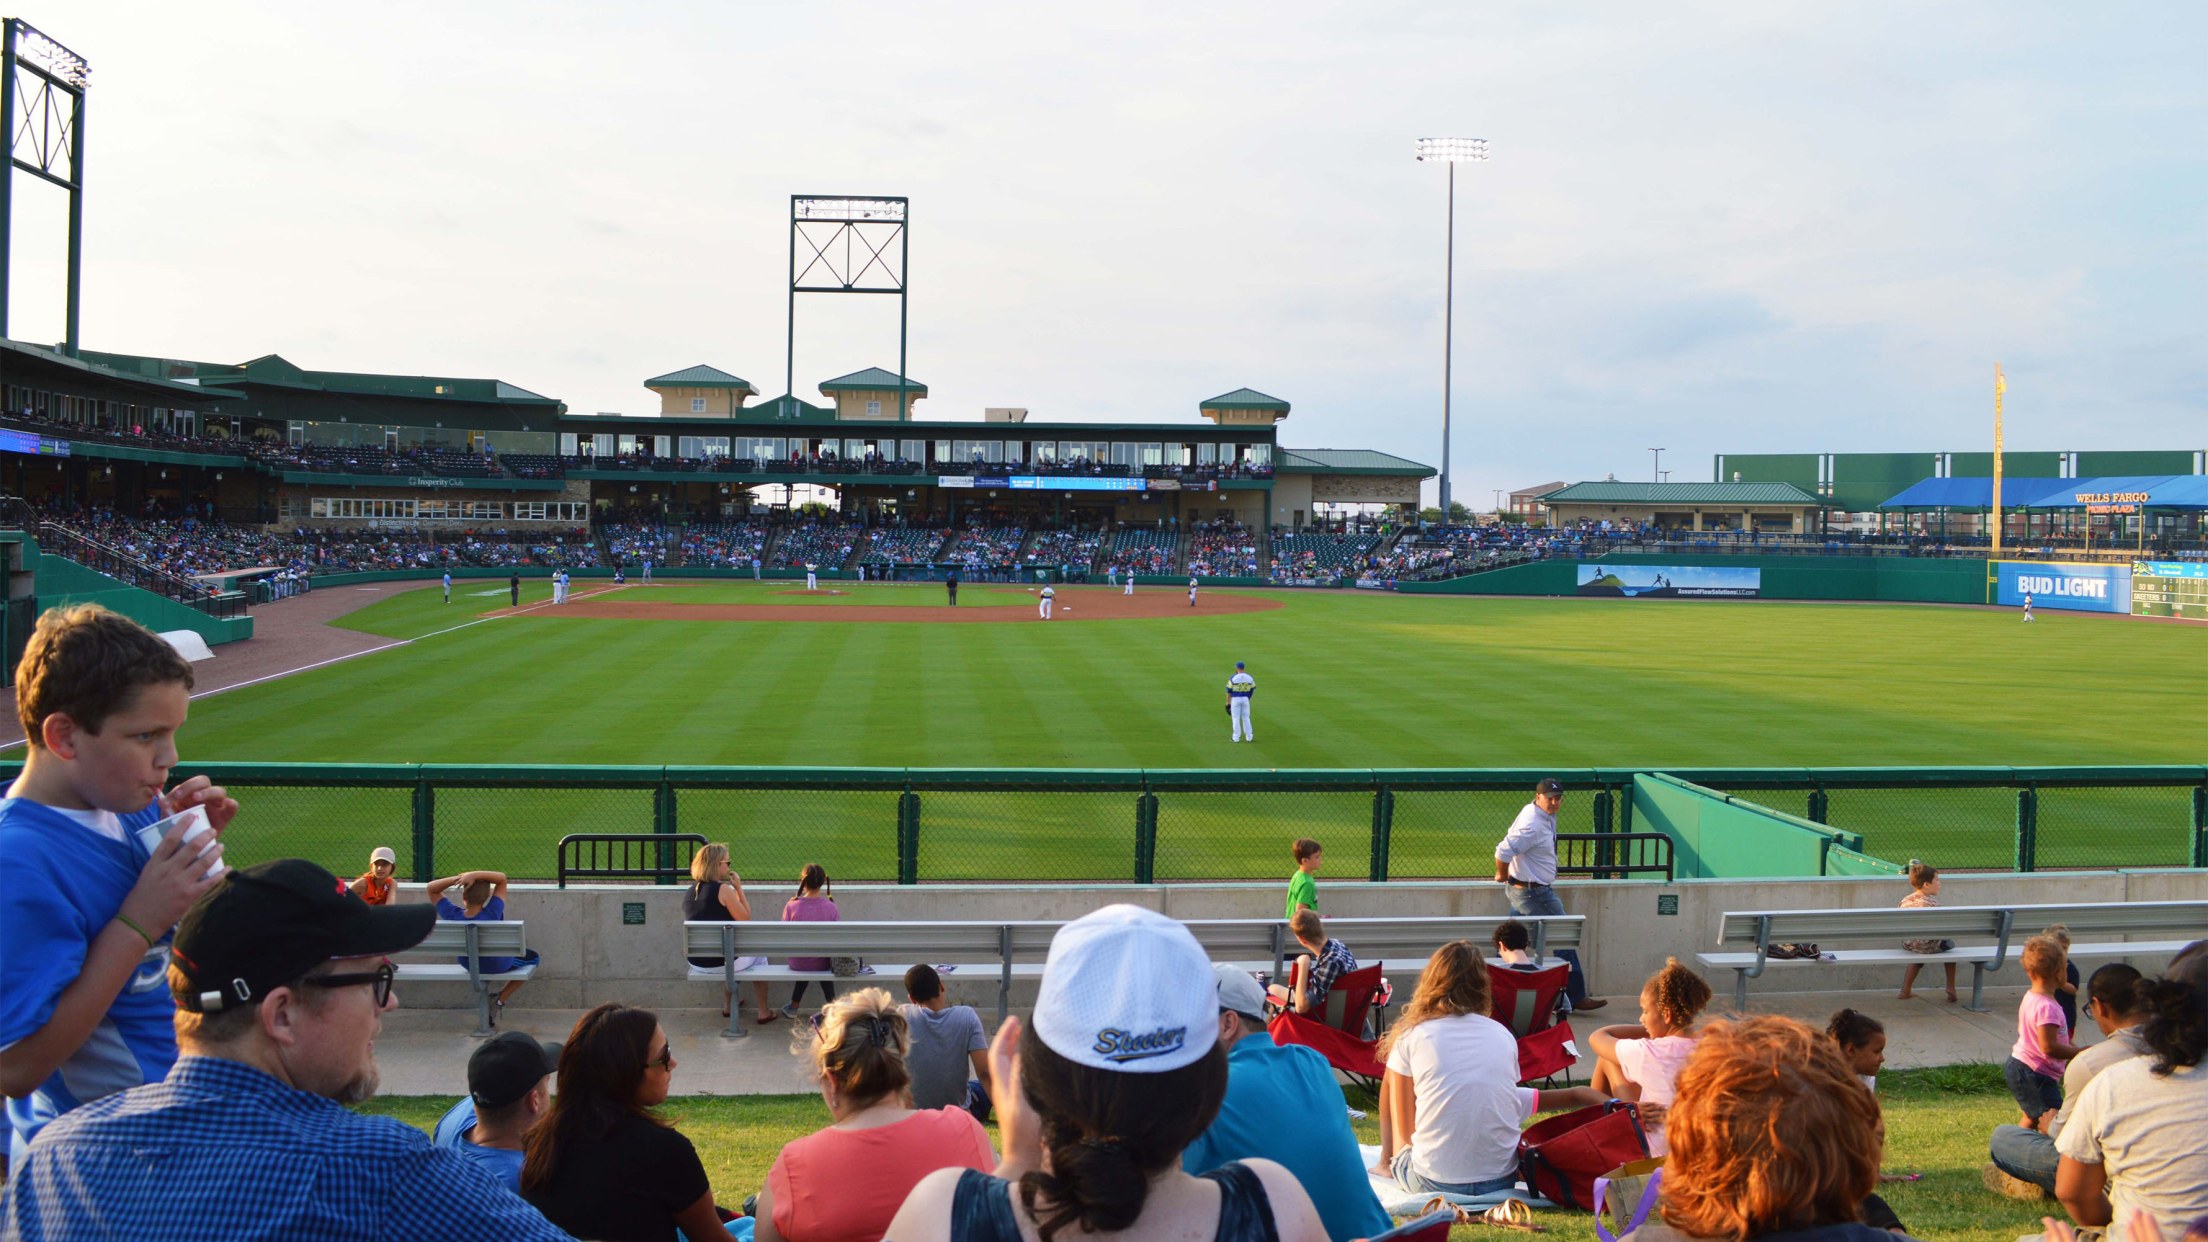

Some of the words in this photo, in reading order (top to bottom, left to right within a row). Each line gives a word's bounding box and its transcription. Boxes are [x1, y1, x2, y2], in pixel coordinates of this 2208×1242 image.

[417, 478, 448, 487] Insperity
[449, 478, 464, 486] Club
[2075, 493, 2110, 503] WELLS
[2112, 492, 2149, 503] FARGO
[2085, 505, 2110, 513] PICNIC
[2110, 504, 2136, 513] PLAZA
[2017, 575, 2054, 595] BUD
[2055, 577, 2107, 598] LIGHT
[1677, 588, 1756, 596] AssuredFlowSolutionsLLC.com
[1092, 1025, 1188, 1055] Skeeters
